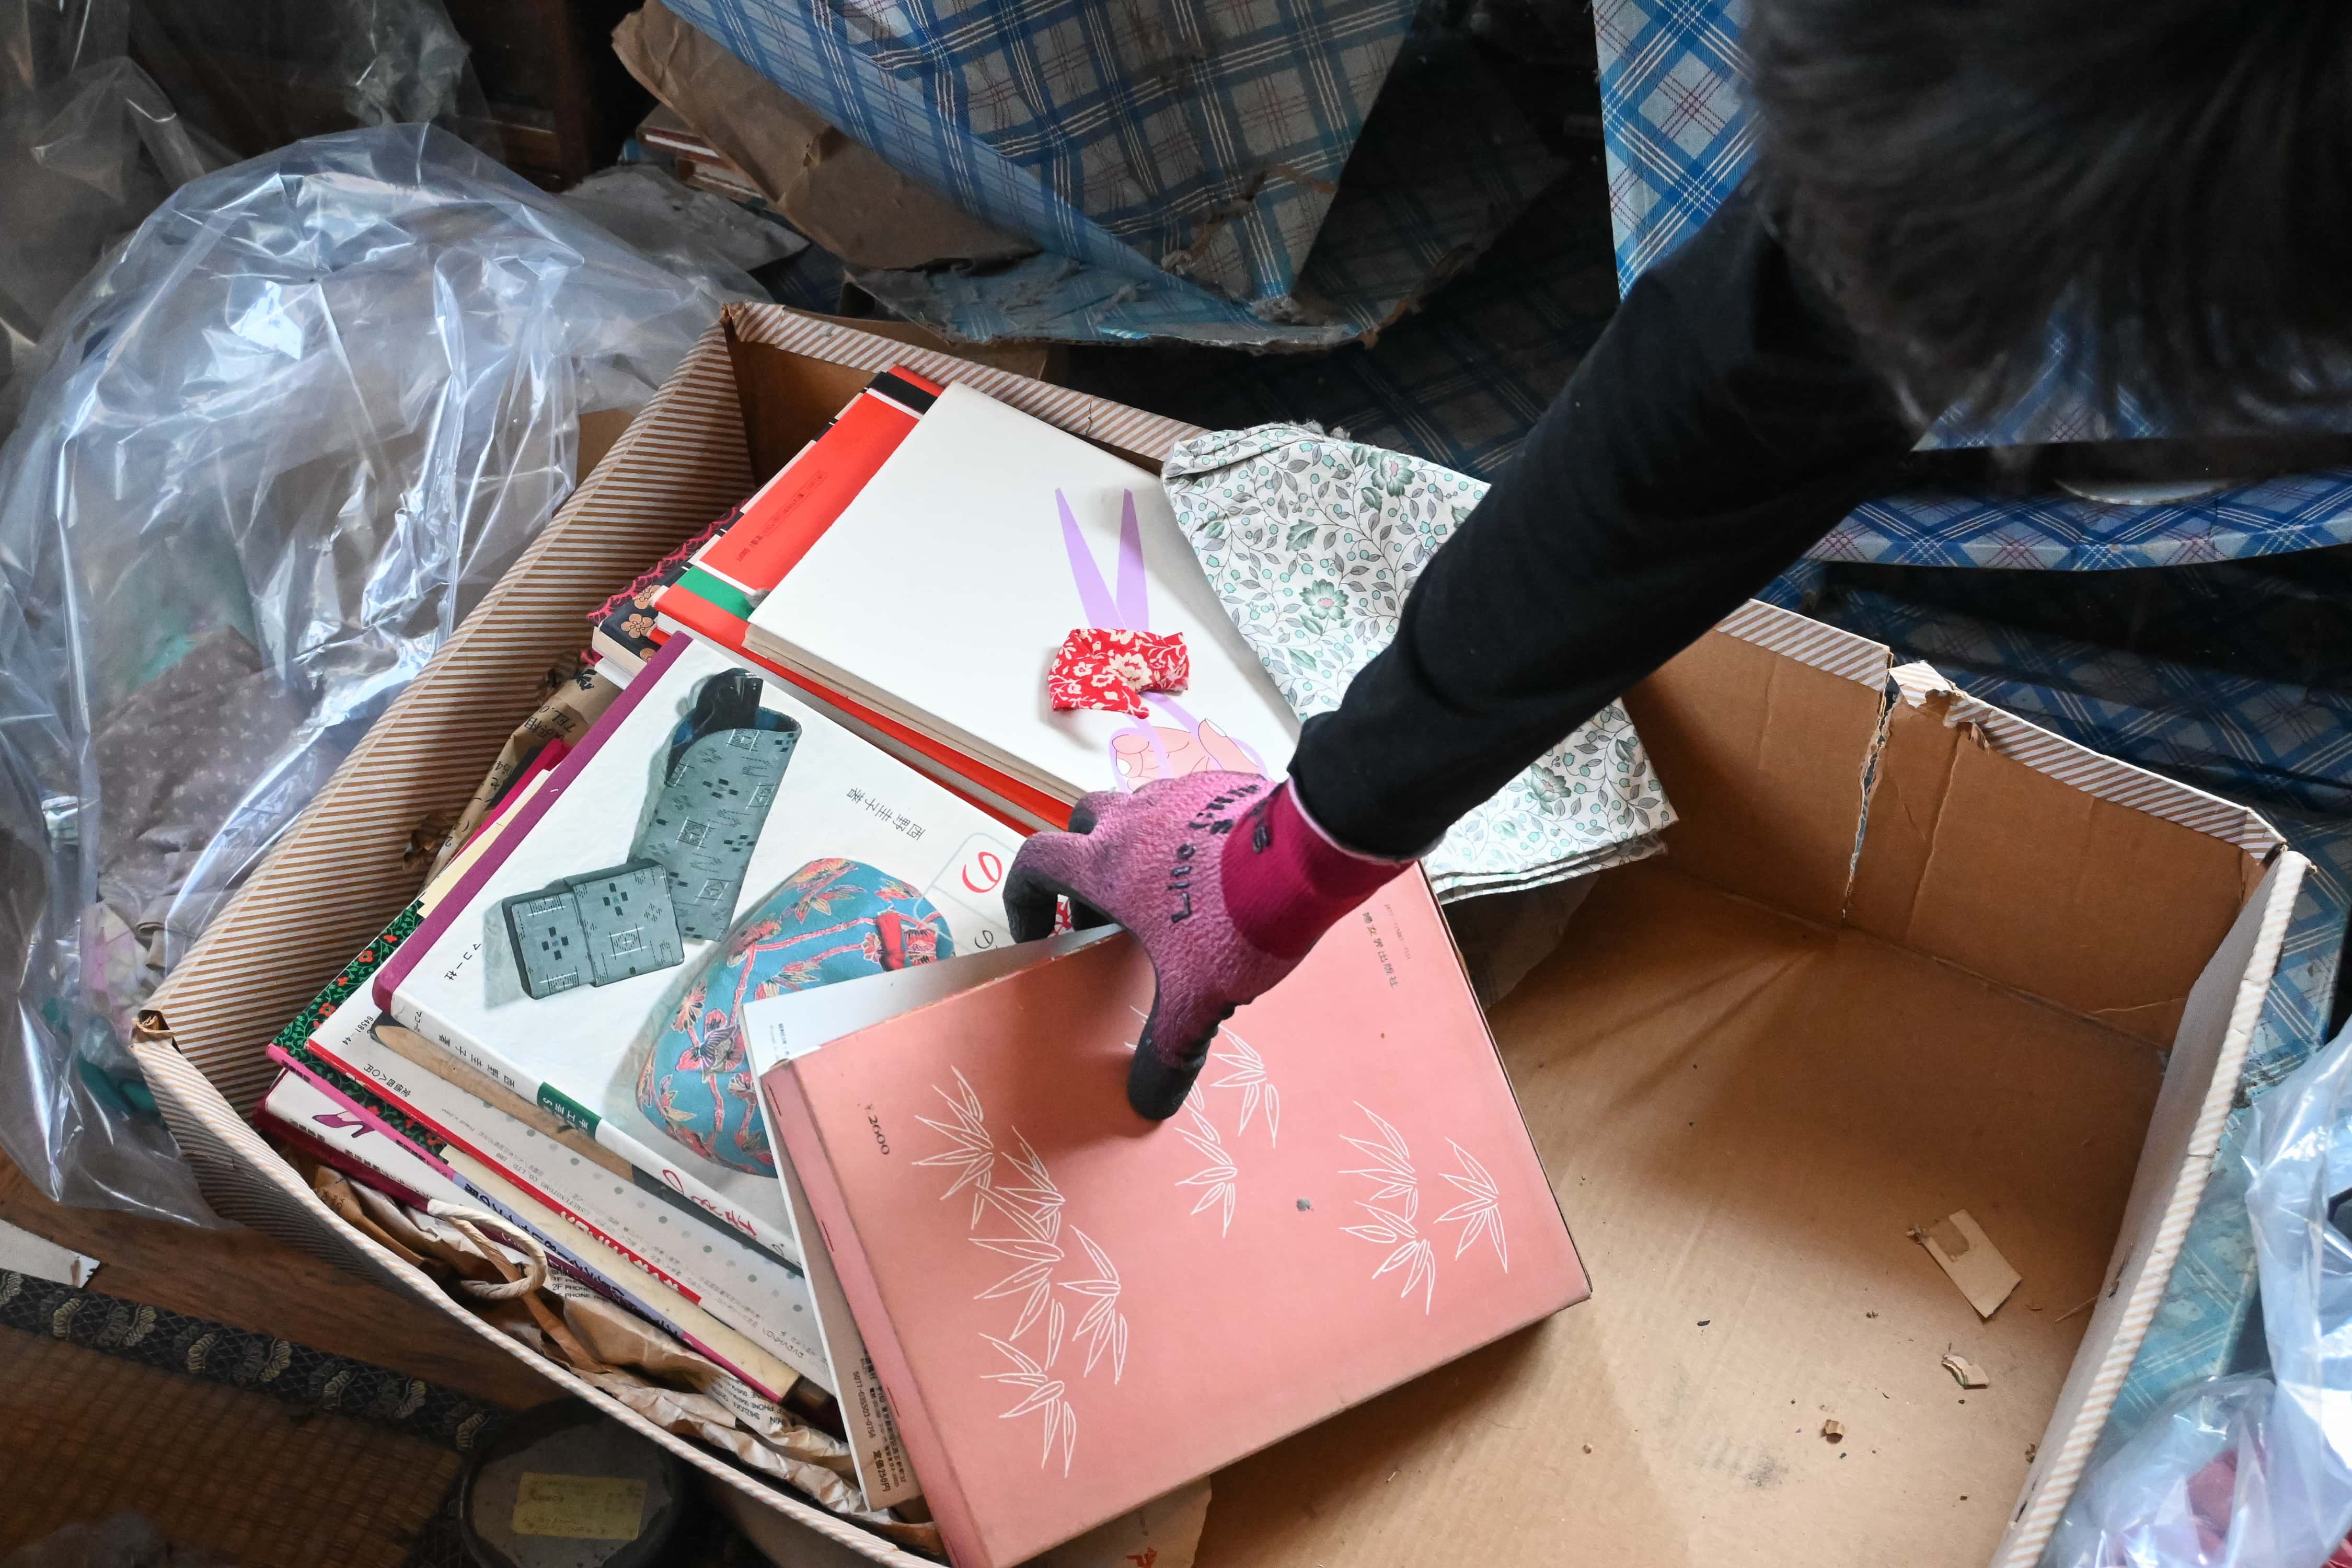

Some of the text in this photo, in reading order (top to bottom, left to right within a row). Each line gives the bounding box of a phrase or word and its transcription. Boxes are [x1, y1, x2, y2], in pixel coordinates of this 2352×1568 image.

[846, 787, 926, 841] 西野圭子著
[961, 851, 1002, 892] の
[443, 943, 481, 982] マコー社
[363, 1063, 411, 1098] 定価四八〇円
